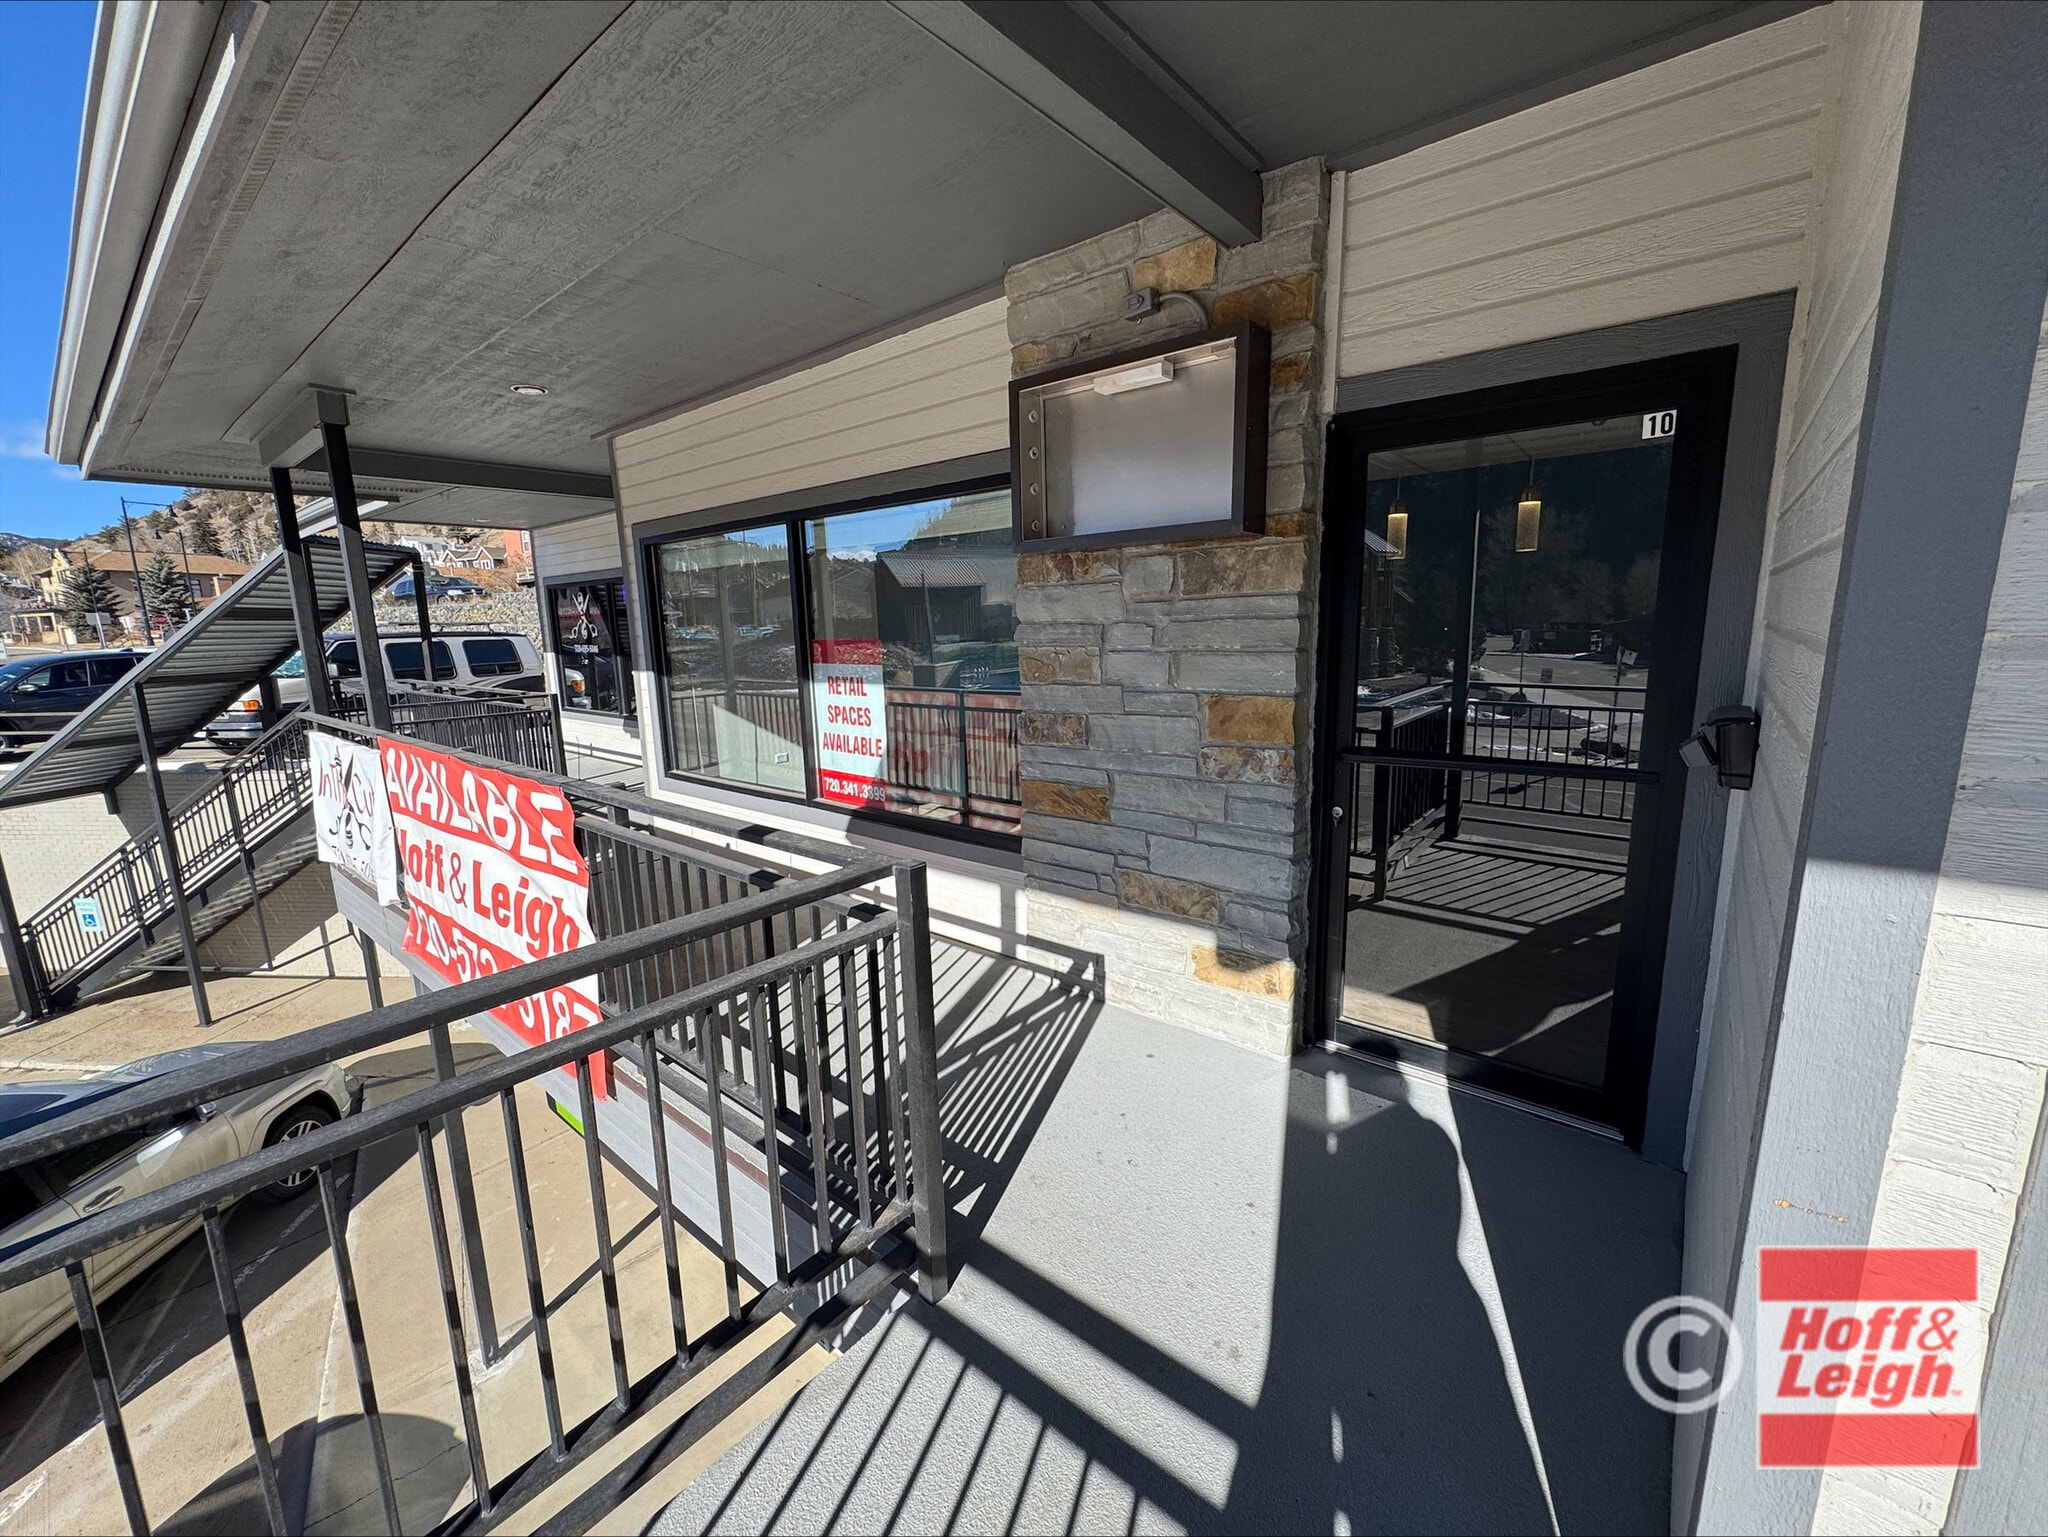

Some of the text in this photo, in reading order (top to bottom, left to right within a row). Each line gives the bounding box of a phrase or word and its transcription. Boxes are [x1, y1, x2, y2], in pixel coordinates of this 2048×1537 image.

[1648, 412, 1674, 436] 10
[827, 675, 867, 697] RETAIL
[827, 704, 871, 727] SPACES
[823, 732, 882, 758] AVAILABLE
[823, 777, 885, 801] 720.341.3399
[386, 747, 578, 875] AVAILABLE
[473, 860, 580, 960] Leigh
